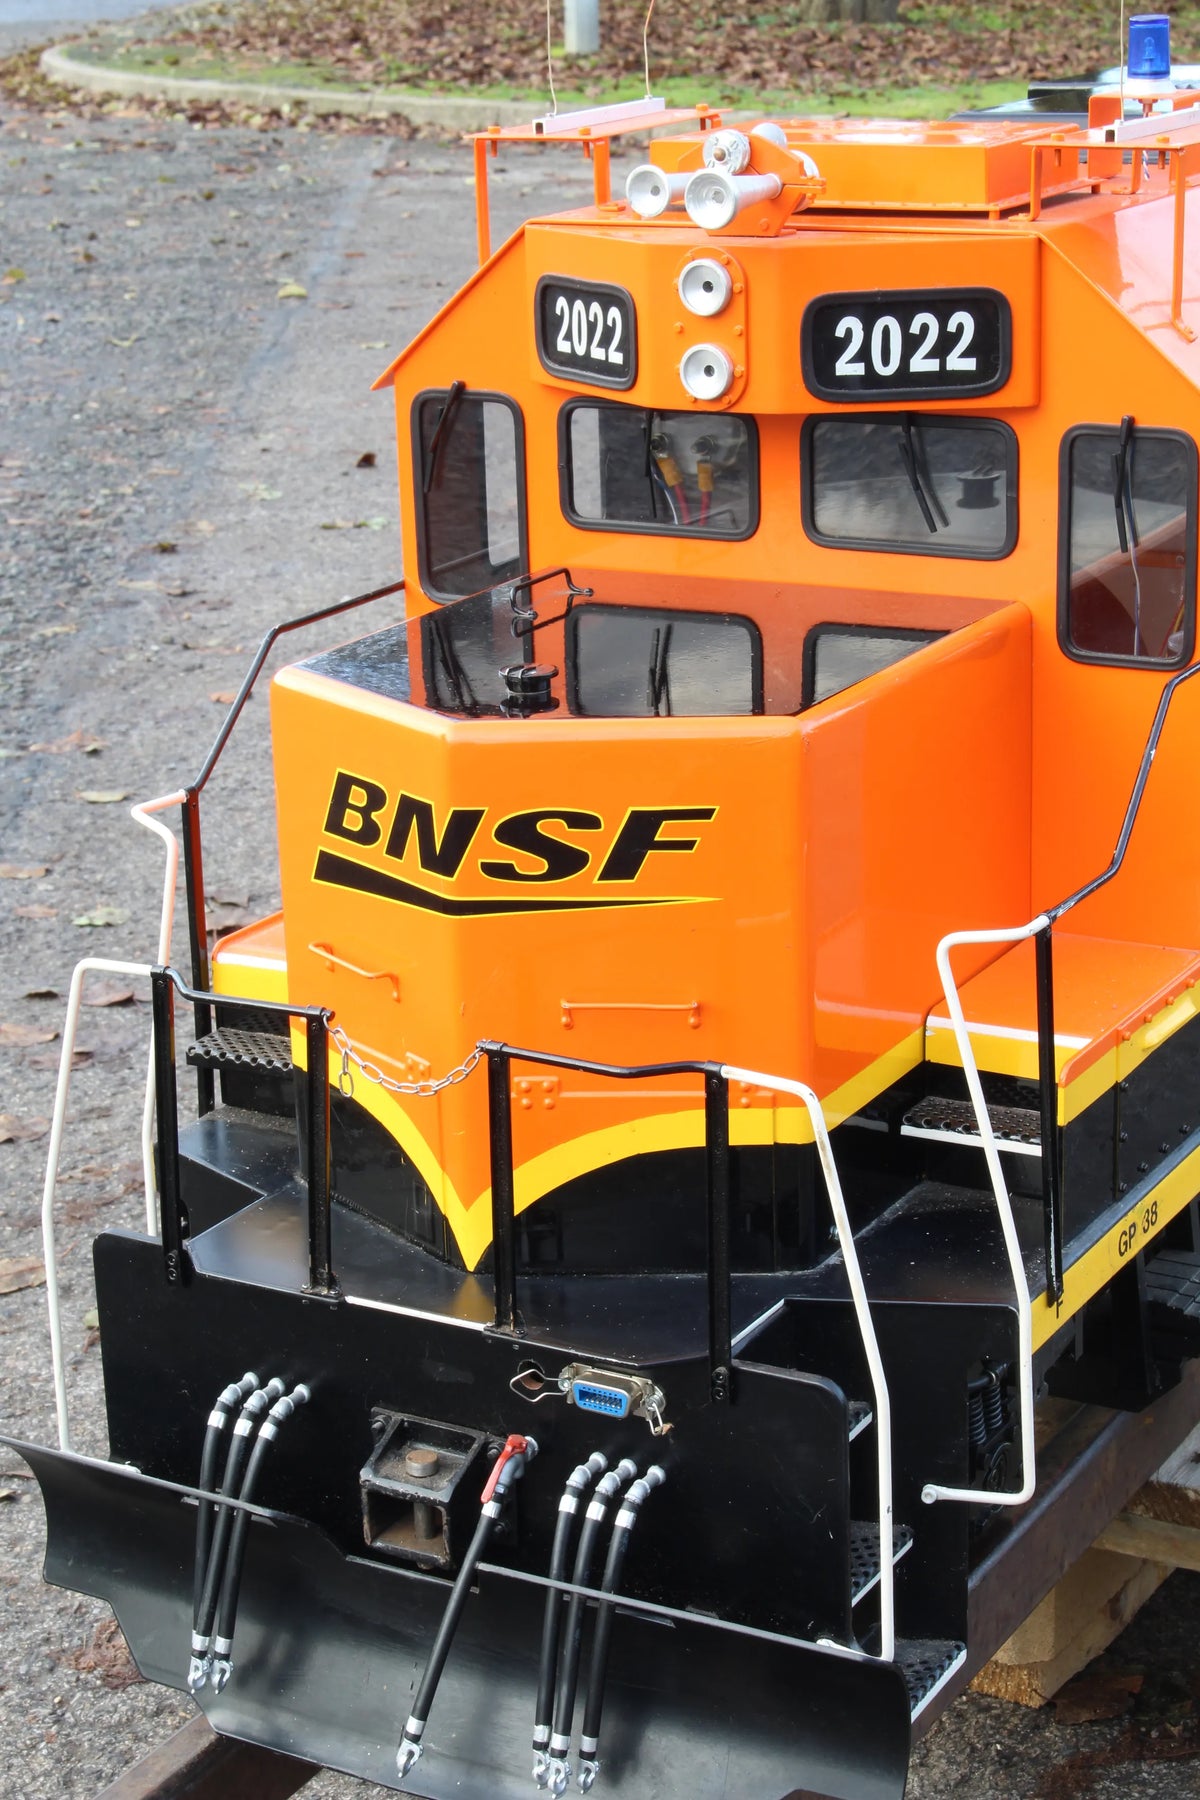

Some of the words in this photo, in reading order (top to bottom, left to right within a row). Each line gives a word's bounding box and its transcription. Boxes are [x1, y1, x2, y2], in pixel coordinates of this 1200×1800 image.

[555, 296, 624, 364] 2022
[834, 310, 977, 376] 2022
[322, 767, 720, 884] BNSF
[1118, 1222, 1136, 1257] GP
[1142, 1201, 1158, 1234] 38
